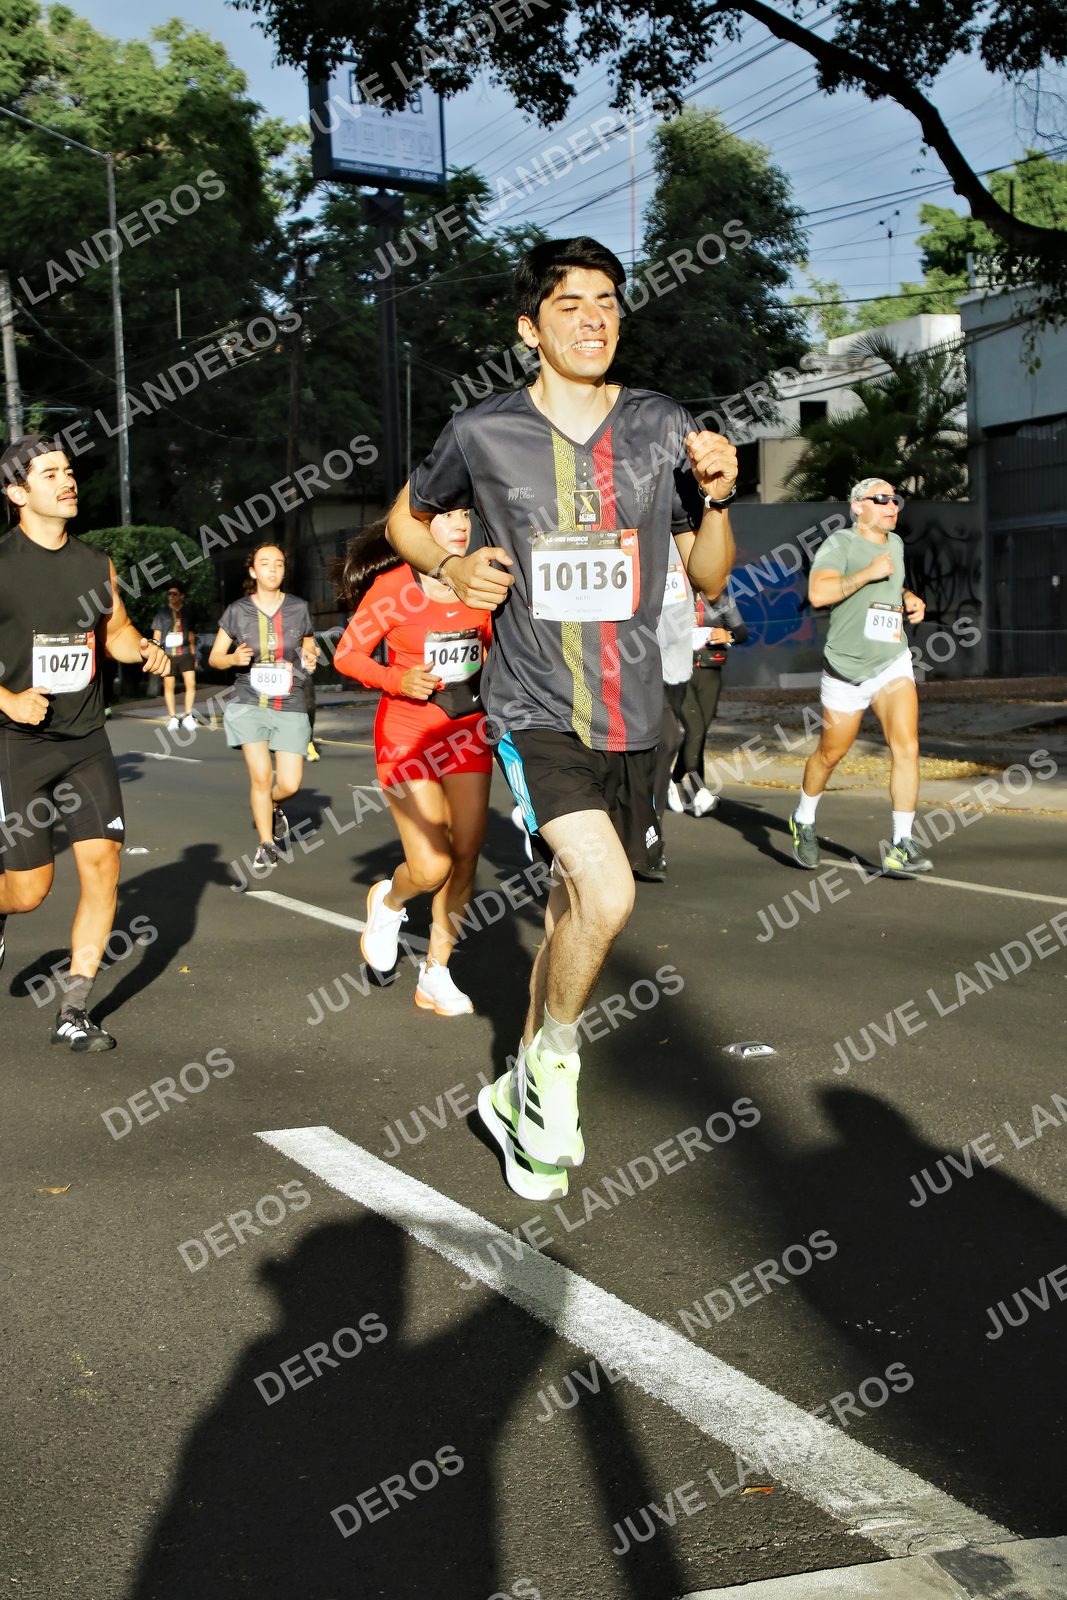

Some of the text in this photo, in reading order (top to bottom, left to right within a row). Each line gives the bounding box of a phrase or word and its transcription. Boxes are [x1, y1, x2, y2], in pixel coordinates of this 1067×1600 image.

[538, 560, 628, 592] 10136
[872, 615, 898, 630] 8181
[38, 652, 90, 673] 10477
[430, 644, 480, 666] 10478
[257, 672, 282, 684] 8801
